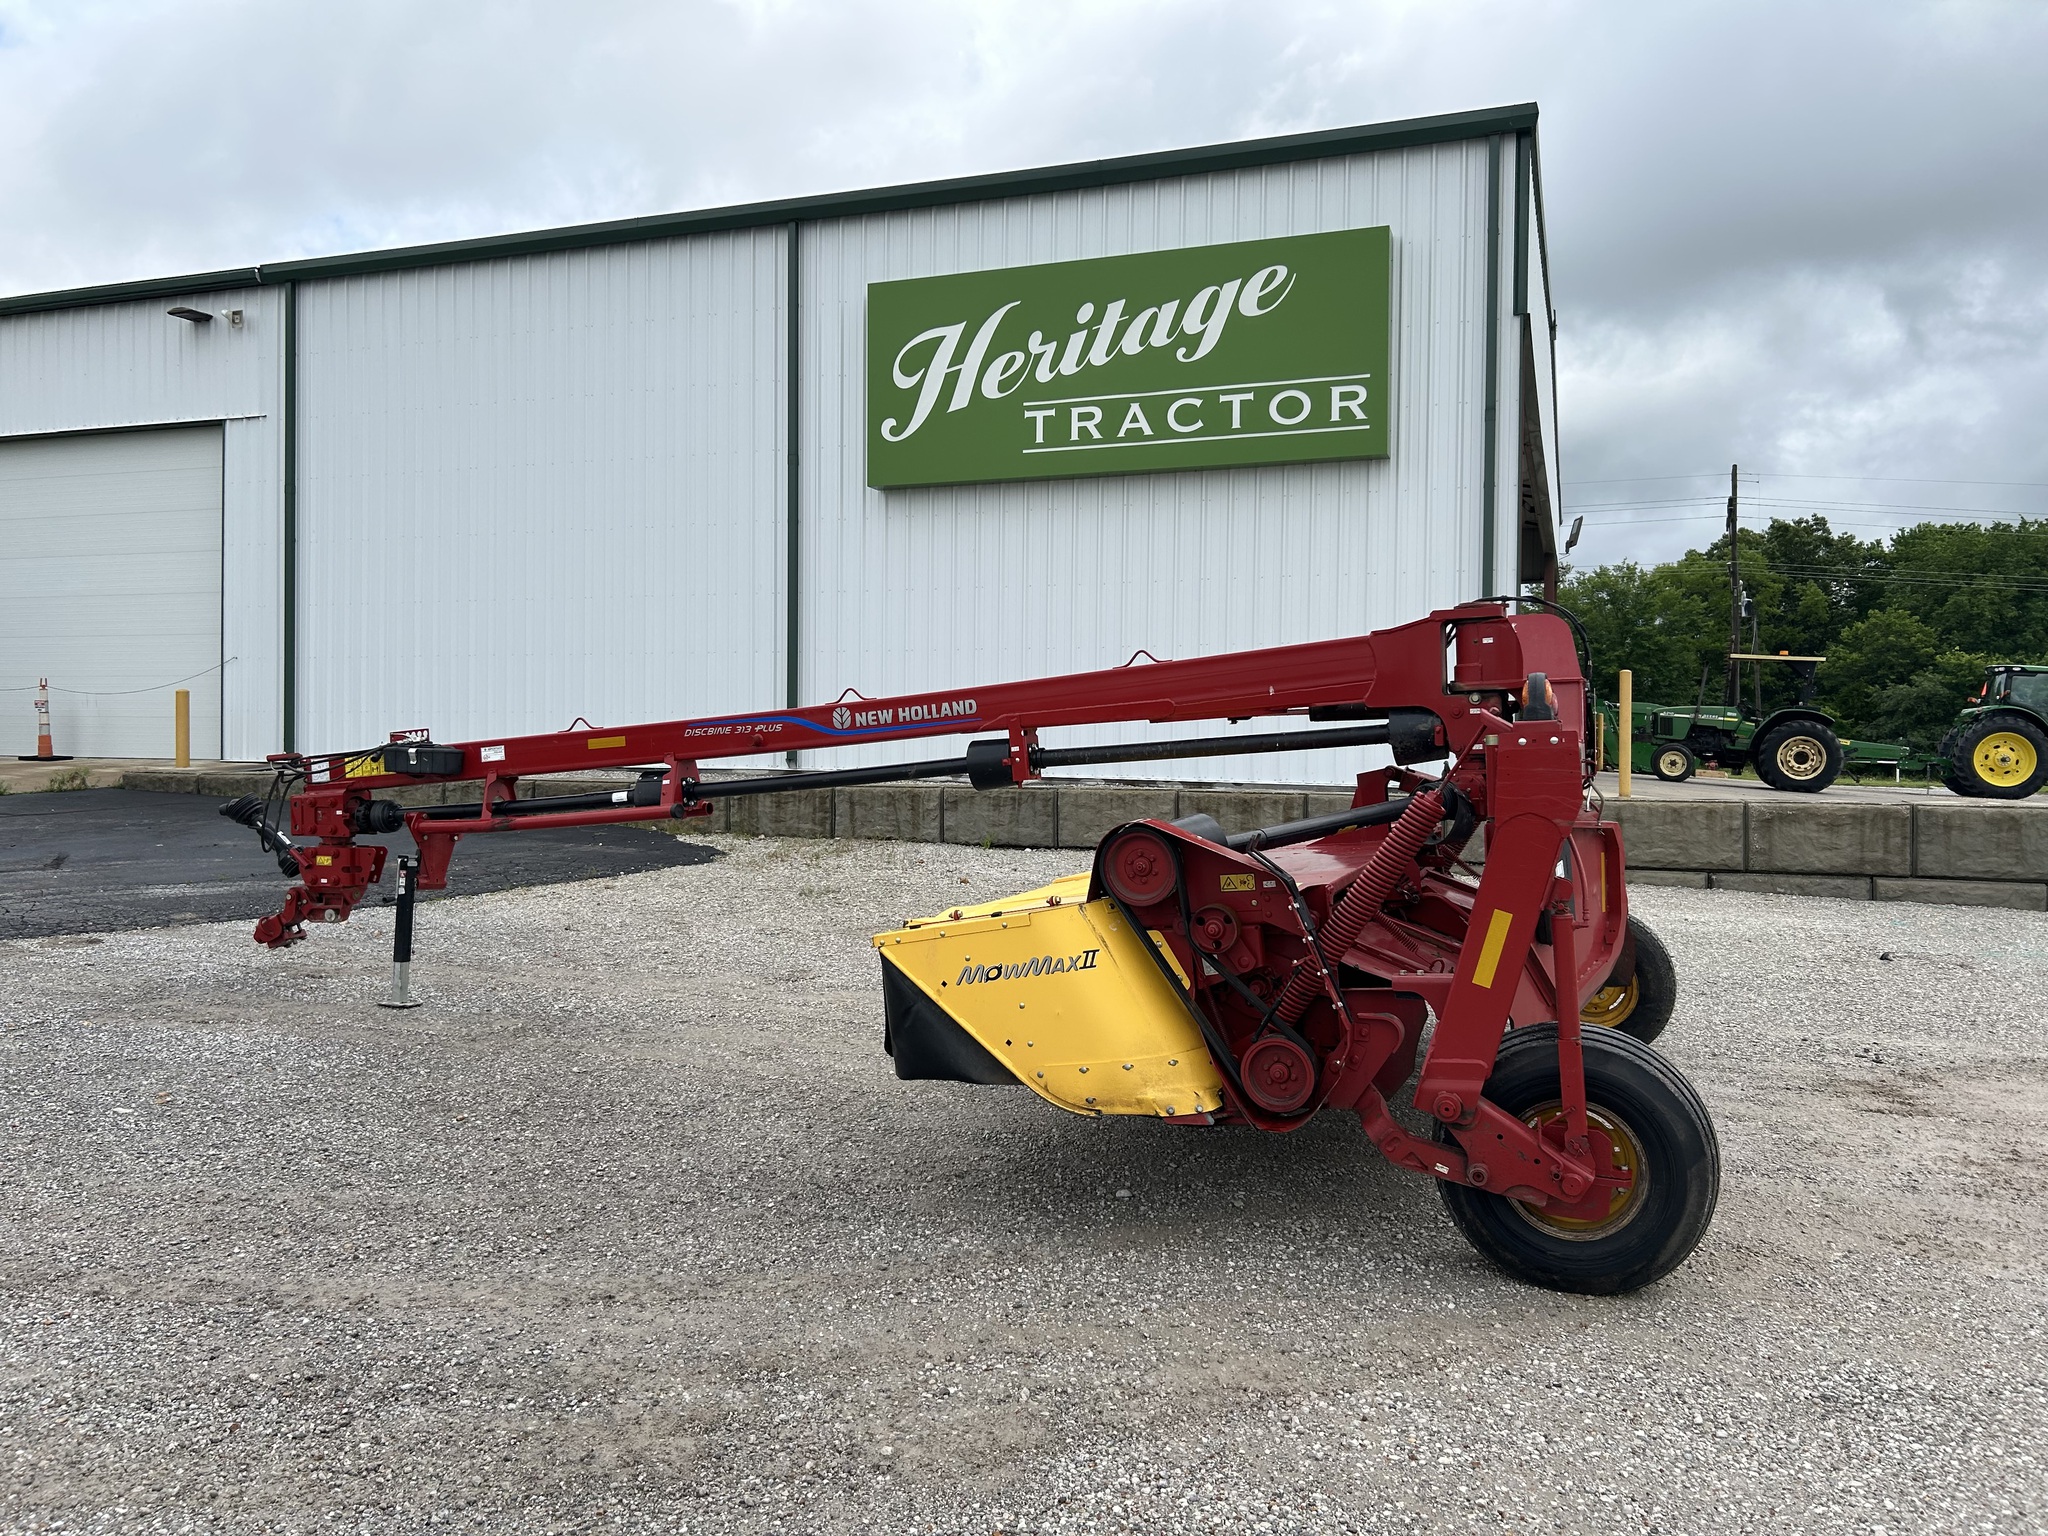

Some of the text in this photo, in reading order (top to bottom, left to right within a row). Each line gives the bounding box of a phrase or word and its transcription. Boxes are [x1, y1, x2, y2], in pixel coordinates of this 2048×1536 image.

[880, 264, 1297, 442] Heritage
[1024, 384, 1369, 444] TRACTOR
[684, 726, 733, 737] DISCBINE
[734, 725, 752, 734] 313
[855, 699, 977, 727] NEW HOLLAND
